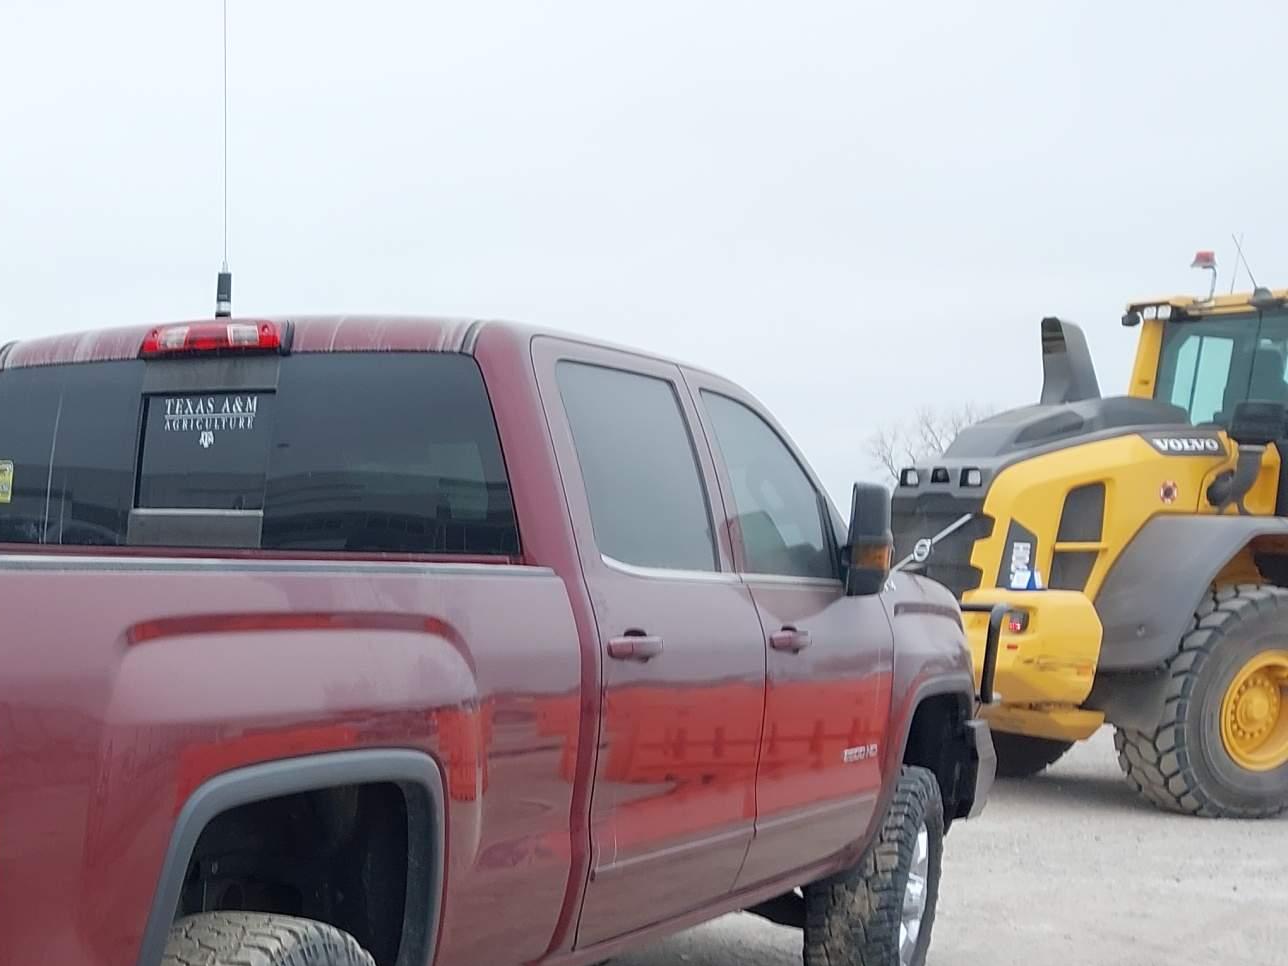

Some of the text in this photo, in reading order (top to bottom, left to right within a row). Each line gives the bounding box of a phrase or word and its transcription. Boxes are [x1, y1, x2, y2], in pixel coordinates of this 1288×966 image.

[165, 396, 258, 415] TEXAS A&M
[164, 416, 254, 431] AGRICULTURE
[1152, 438, 1219, 451] VOLVO
